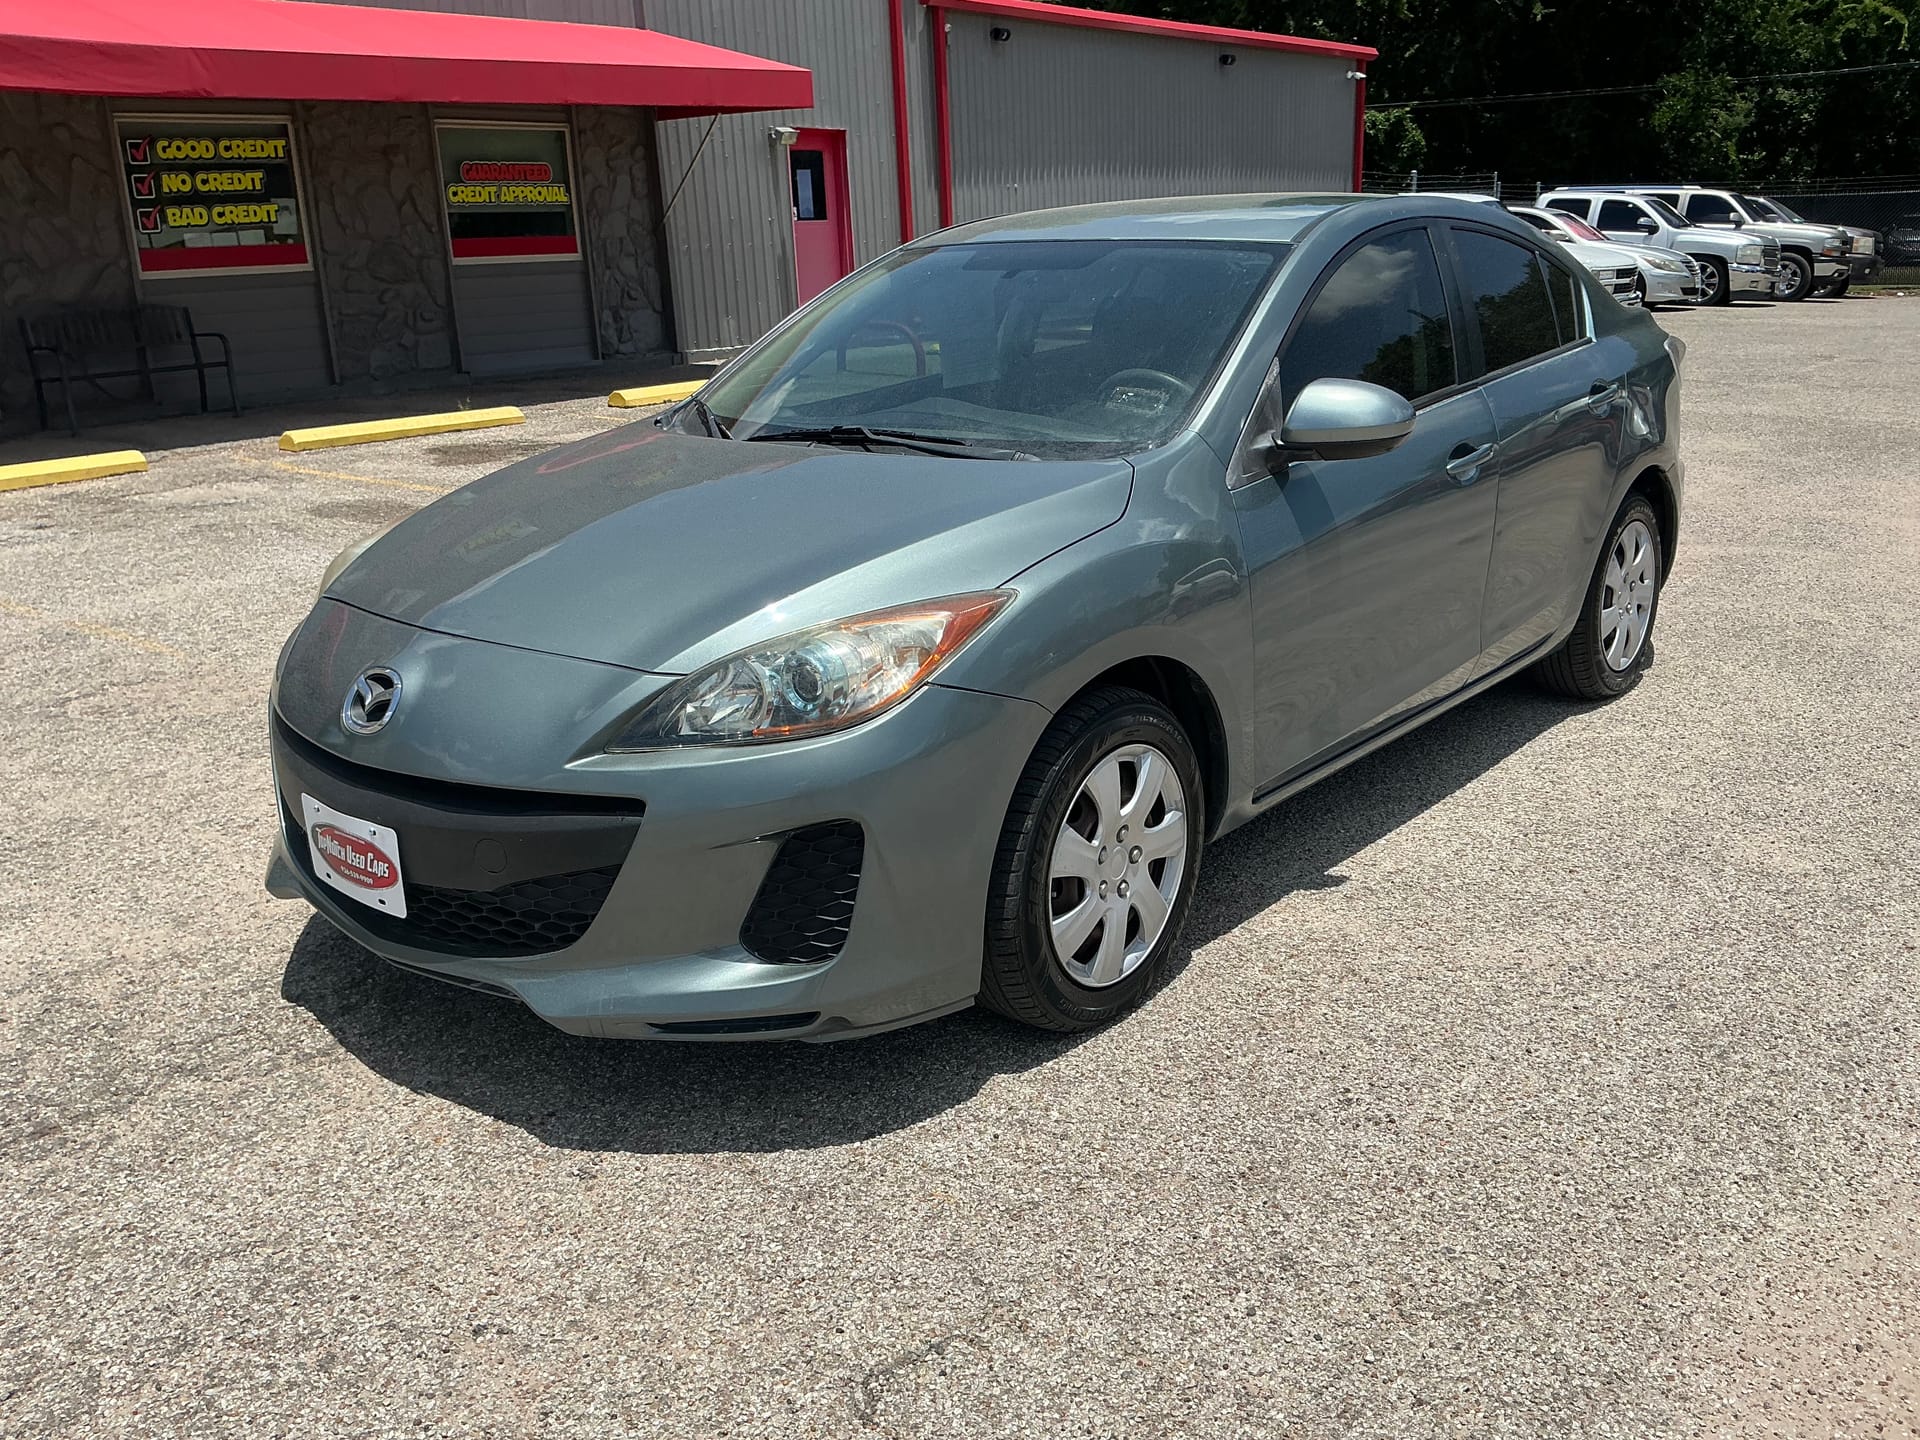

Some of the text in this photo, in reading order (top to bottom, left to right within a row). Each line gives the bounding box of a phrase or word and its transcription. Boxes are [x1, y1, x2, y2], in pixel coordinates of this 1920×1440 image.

[156, 139, 287, 159] GOOD CREDIT
[161, 171, 264, 193] NO CREDIT
[461, 162, 551, 181] GUARANTEED
[448, 184, 569, 204] CREDIT APPROVAL
[166, 204, 279, 227] BAD CREDIT
[346, 845, 365, 869] USED
[367, 852, 389, 877] CARS
